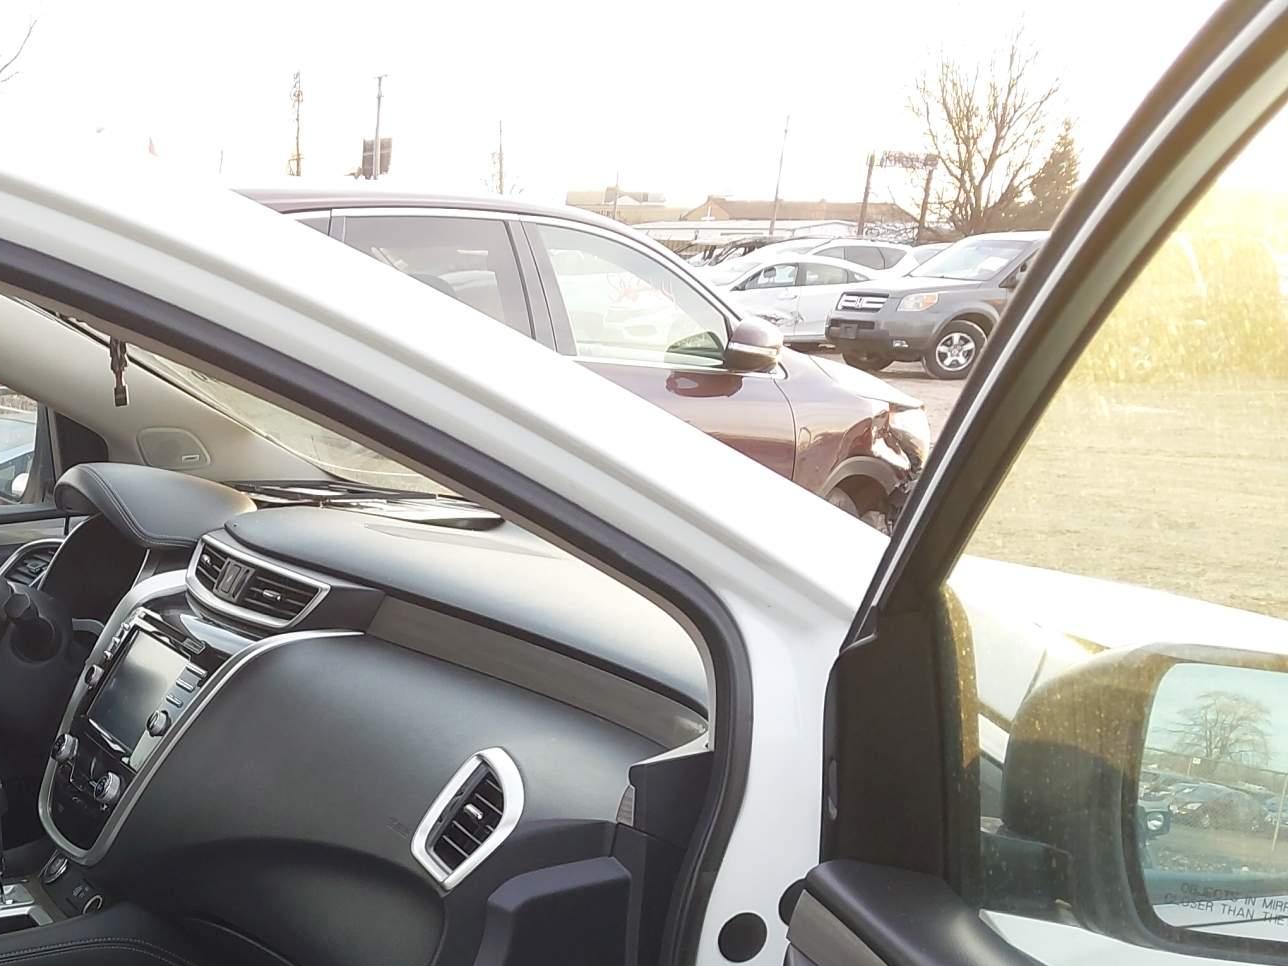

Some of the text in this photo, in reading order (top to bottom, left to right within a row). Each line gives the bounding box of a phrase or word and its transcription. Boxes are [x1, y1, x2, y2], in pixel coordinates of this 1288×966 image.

[1165, 893, 1214, 912] COSER
[1221, 903, 1255, 920] THAN
[1244, 896, 1257, 907] IN
